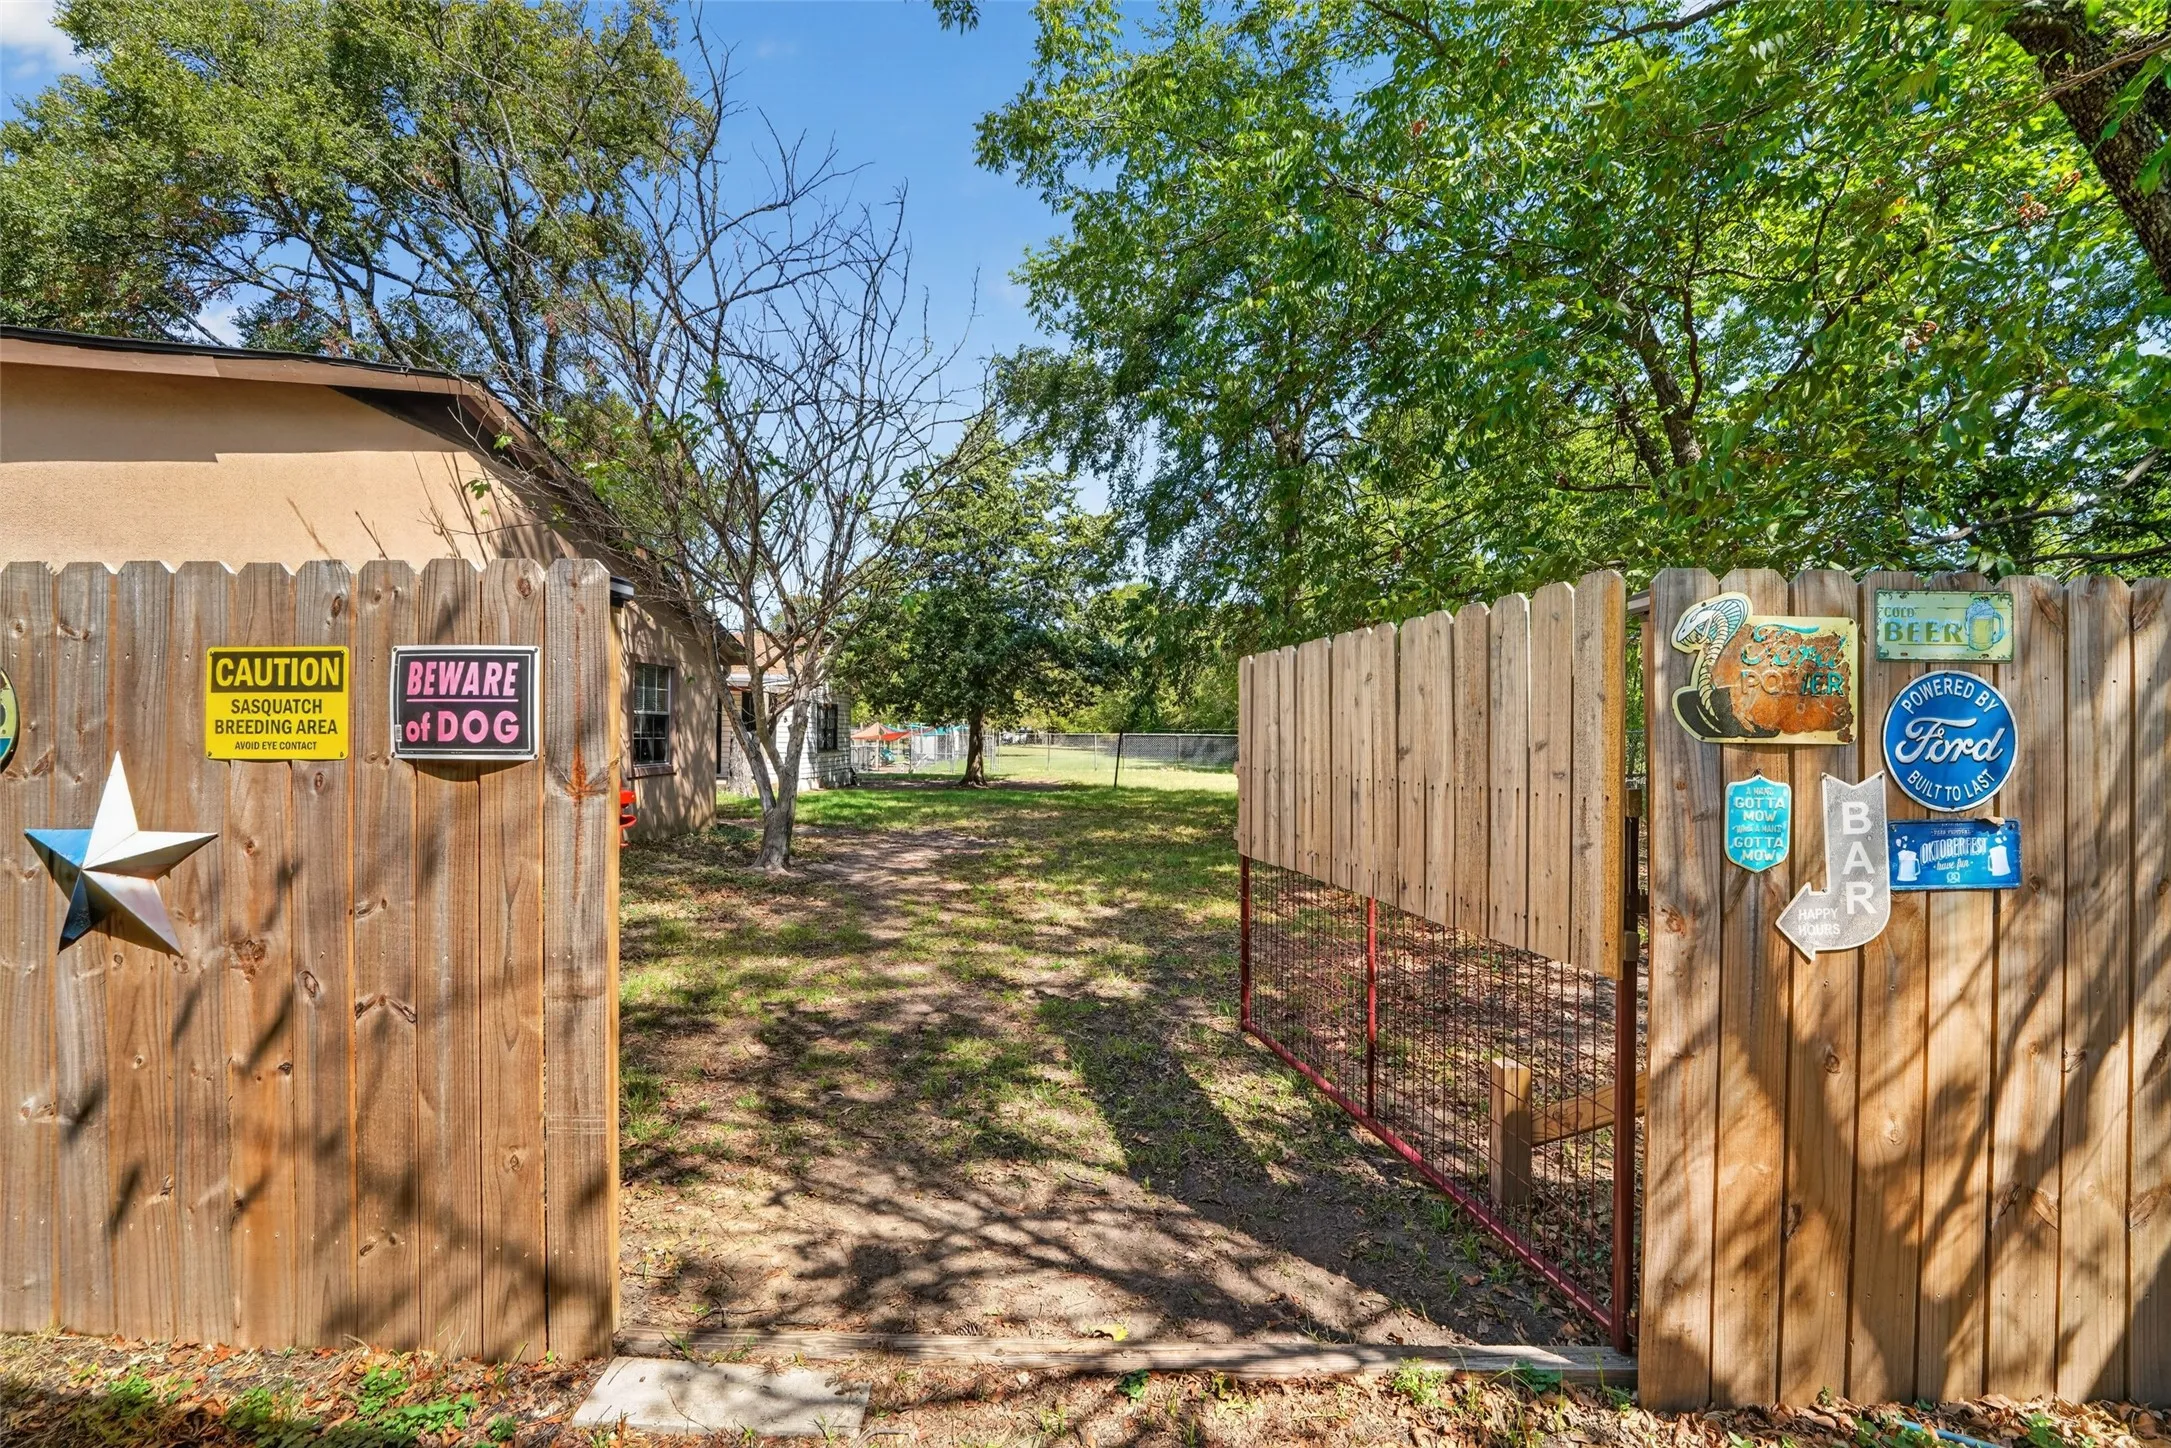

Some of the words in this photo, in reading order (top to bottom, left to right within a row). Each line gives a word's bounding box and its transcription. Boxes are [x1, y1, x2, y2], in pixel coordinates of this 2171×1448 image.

[1884, 606, 1915, 618] COLD
[1884, 621, 1963, 643] BEER
[1741, 623, 1847, 669] Ford
[215, 657, 340, 687] CAUTION
[406, 661, 520, 696] BEWARE
[1901, 677, 1975, 715] POWERED
[1974, 690, 2000, 713] BY
[231, 699, 323, 717] SASQUATCH
[215, 719, 292, 735] BREEDING
[296, 719, 338, 735] AREA
[406, 711, 431, 743] of
[437, 709, 519, 744] DOG
[235, 741, 260, 750] AVOID
[261, 741, 278, 750] EYE
[280, 741, 317, 750] CONTACT
[1894, 717, 2006, 764] Ford
[1907, 770, 1943, 800] BUILT
[1945, 785, 1961, 801] TO
[1963, 768, 1996, 799] LAST
[1734, 797, 1786, 809] GOTTA
[1743, 809, 1777, 822] MOW
[1733, 836, 1784, 848] GOTTA
[1920, 836, 1989, 865] OKTOBERFEST
[1742, 849, 1776, 861] MOW
[1841, 801, 1877, 914] BAR
[1798, 907, 1839, 921] HAPPY
[1798, 923, 1841, 936] HOURS
